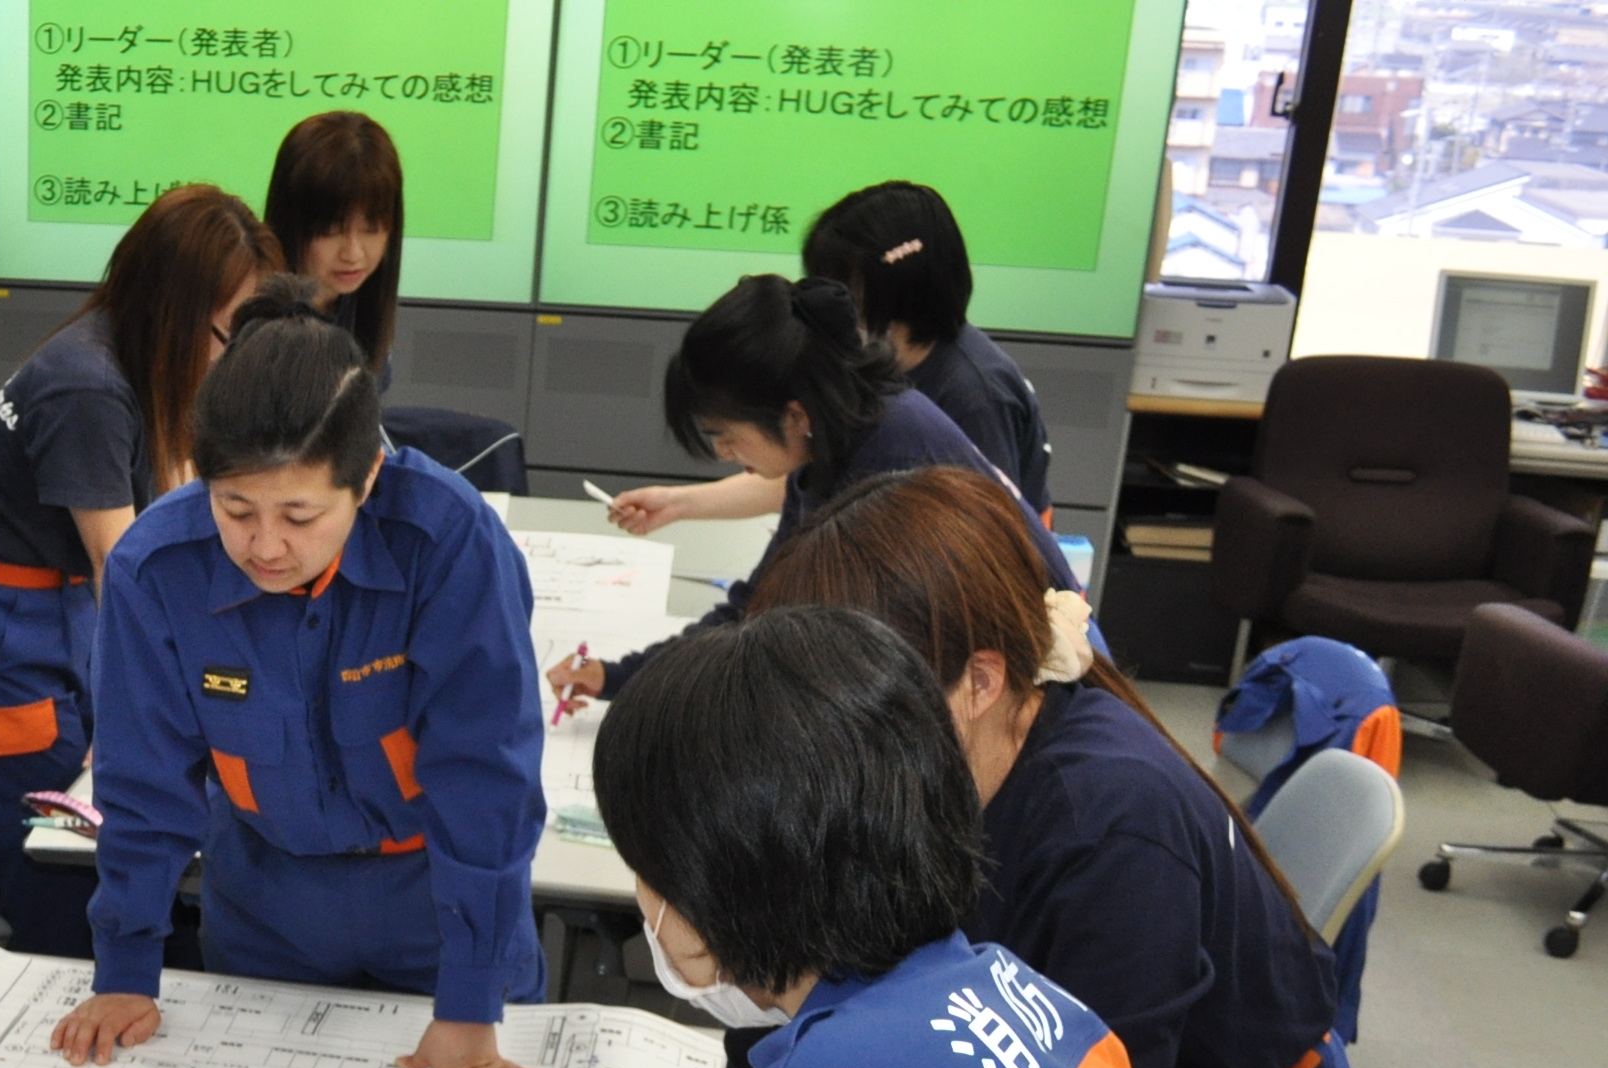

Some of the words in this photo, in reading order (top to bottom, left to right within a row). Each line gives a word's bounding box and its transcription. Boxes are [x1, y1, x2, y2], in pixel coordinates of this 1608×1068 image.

[34, 98, 123, 133] ②書記
[600, 115, 700, 152] ②書記
[594, 193, 791, 235] ③読み上げ係
